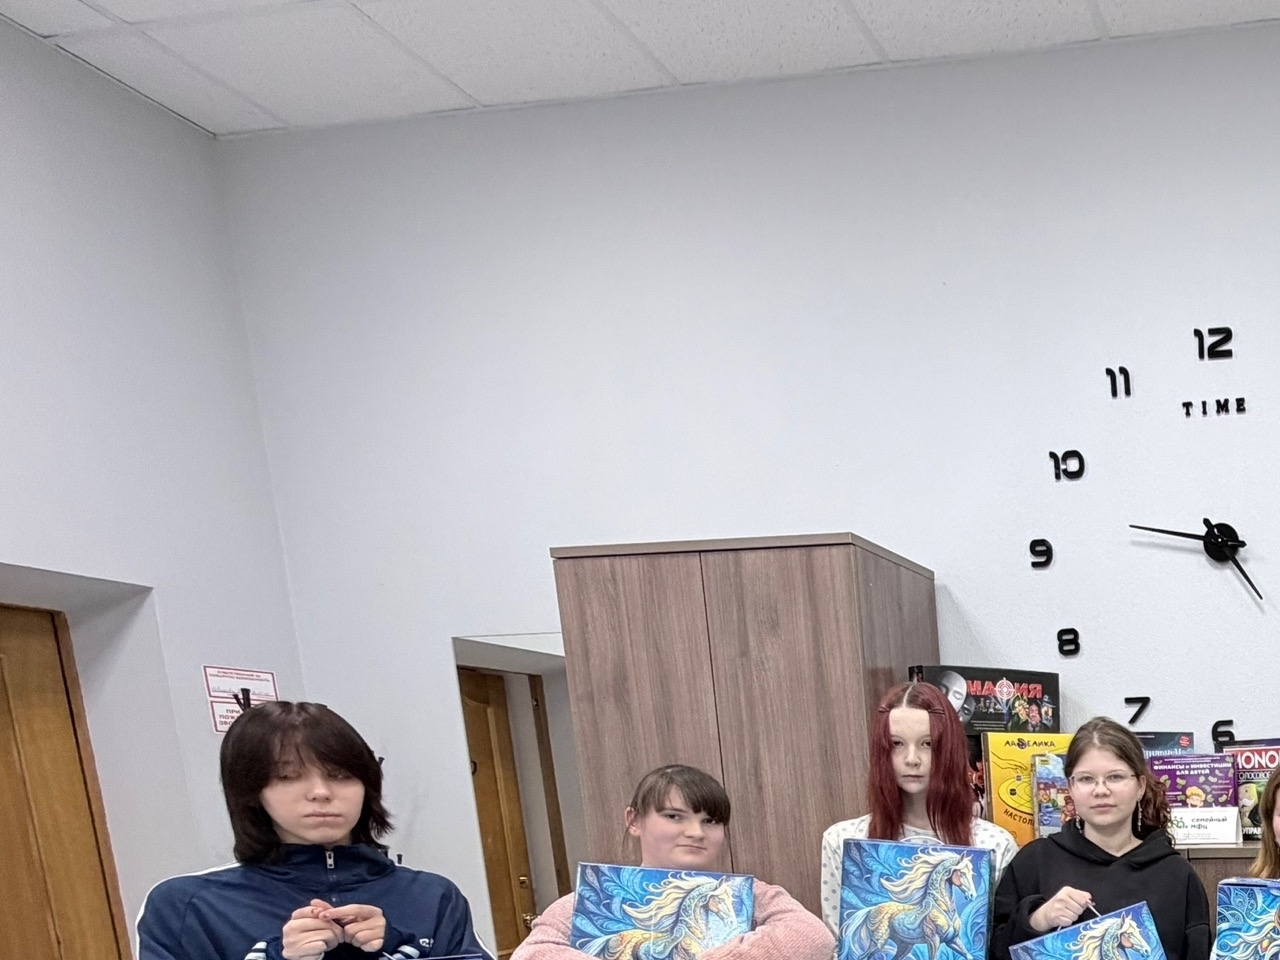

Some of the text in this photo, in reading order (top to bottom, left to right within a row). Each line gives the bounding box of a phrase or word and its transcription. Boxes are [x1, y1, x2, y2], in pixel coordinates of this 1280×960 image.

[1193, 326, 1233, 360] 12
[1105, 366, 1132, 398] 11
[1182, 397, 1246, 418] TIME
[1049, 450, 1085, 481] 10
[1029, 538, 1054, 569] 9
[1057, 628, 1081, 657] 8
[1124, 696, 1151, 724] 7
[1211, 720, 1236, 743] 6
[1238, 771, 1271, 780] ОЛОСОВОЕ
[1003, 808, 1035, 827] НАСТОЛ
[1242, 826, 1262, 835] УПРАВ
